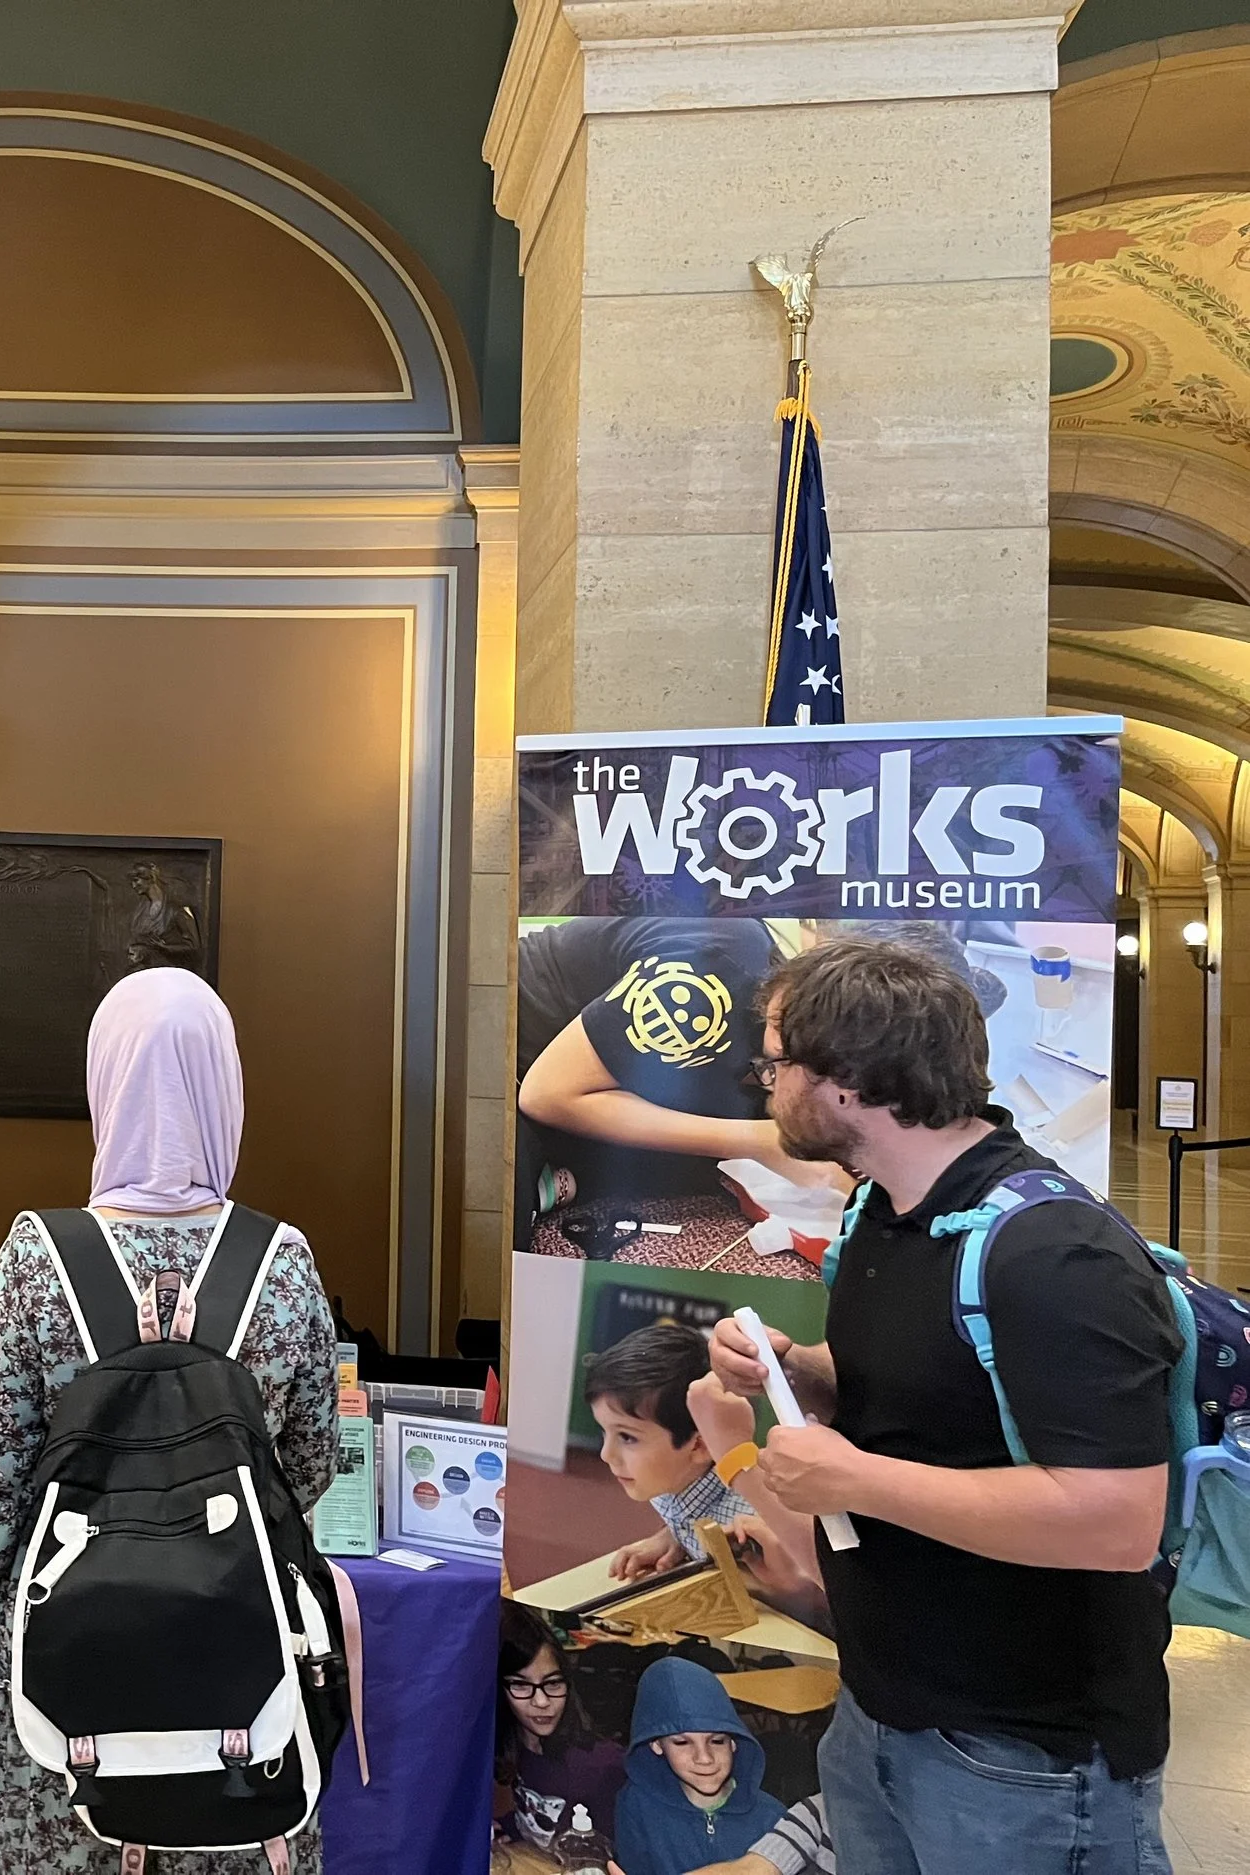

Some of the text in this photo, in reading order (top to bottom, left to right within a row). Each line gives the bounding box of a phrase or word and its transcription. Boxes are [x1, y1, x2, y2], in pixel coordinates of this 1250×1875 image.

[573, 757, 640, 792] the
[841, 879, 1040, 909] museum
[405, 1429, 457, 1443] ENGINEERING
[458, 1436, 487, 1447] DESIGN
